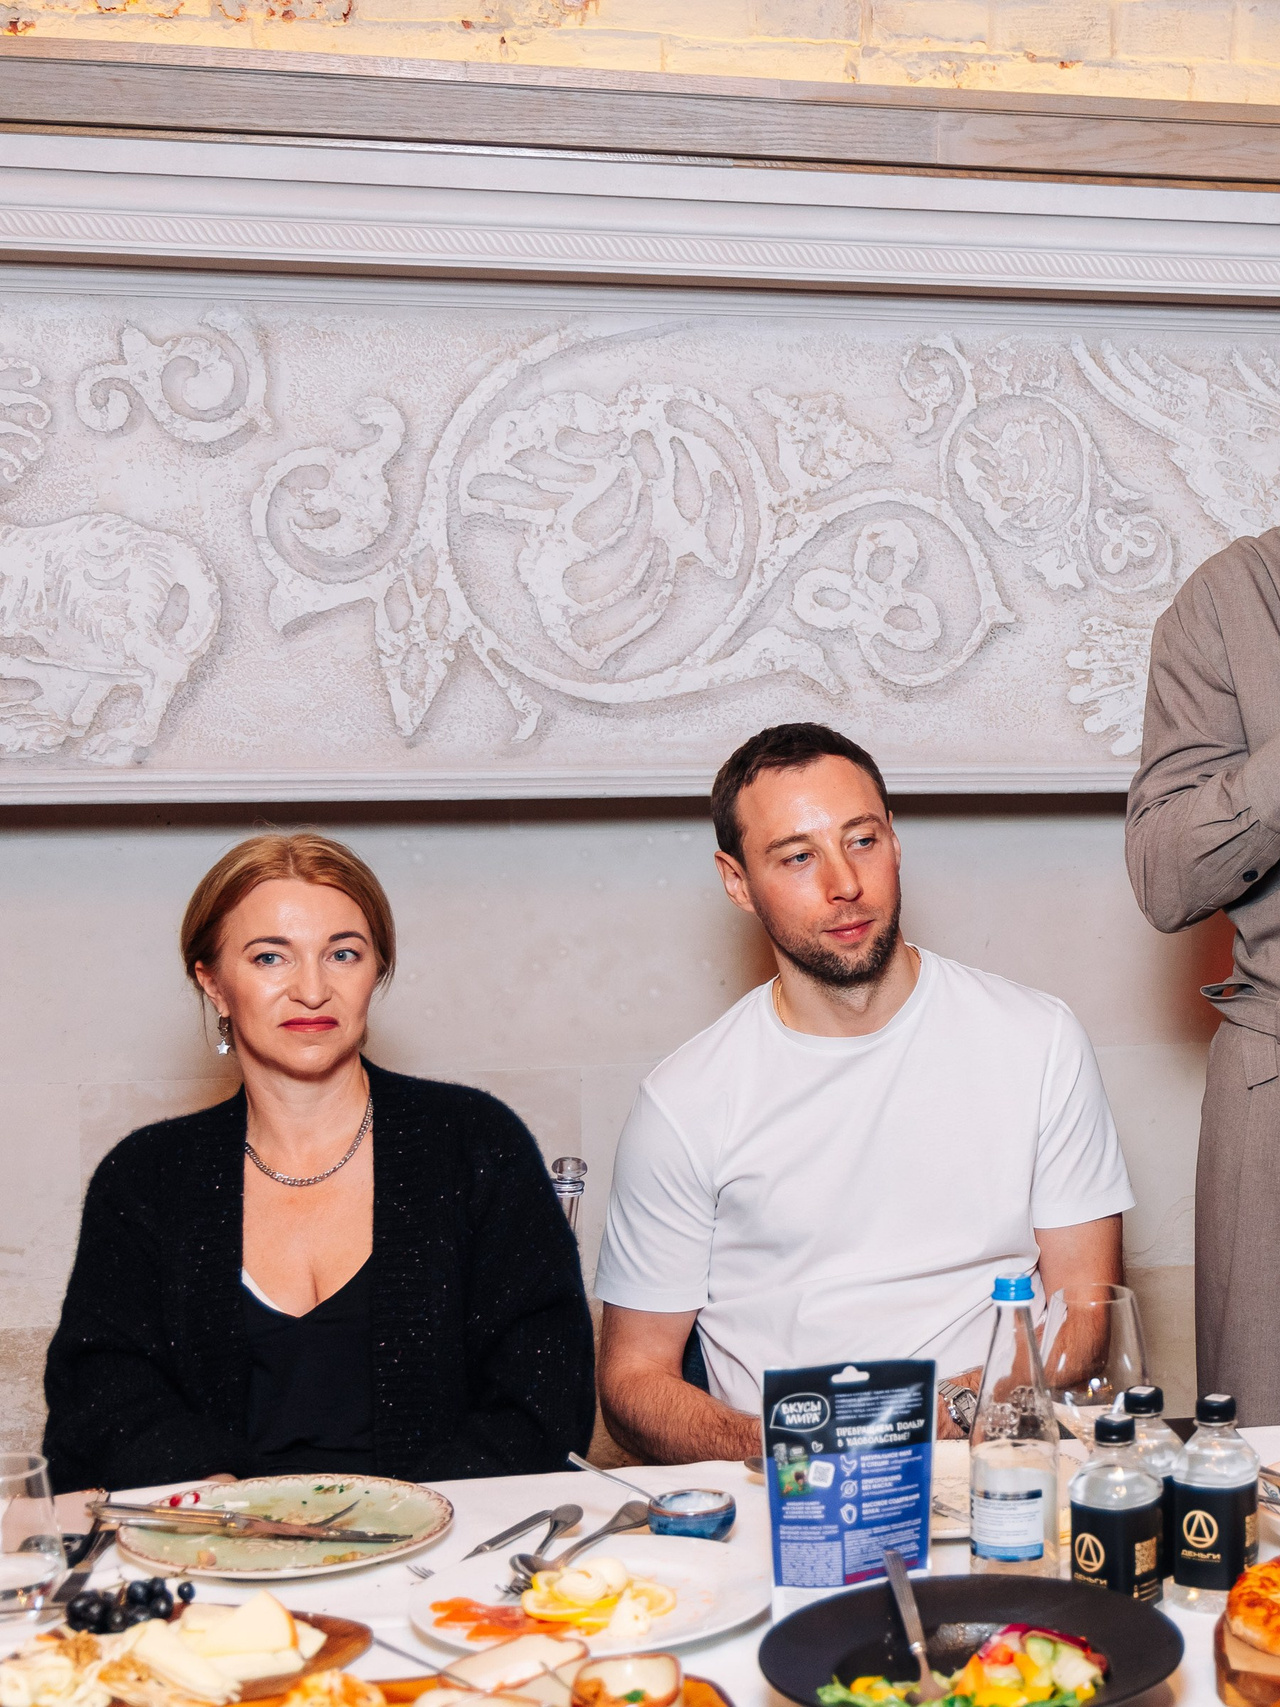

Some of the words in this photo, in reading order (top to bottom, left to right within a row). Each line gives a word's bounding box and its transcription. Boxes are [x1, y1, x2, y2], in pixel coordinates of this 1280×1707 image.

[781, 1401, 822, 1415] ВКУСЫ
[785, 1412, 820, 1425] МИРА
[897, 1419, 925, 1431] ПОЛЬЗУ
